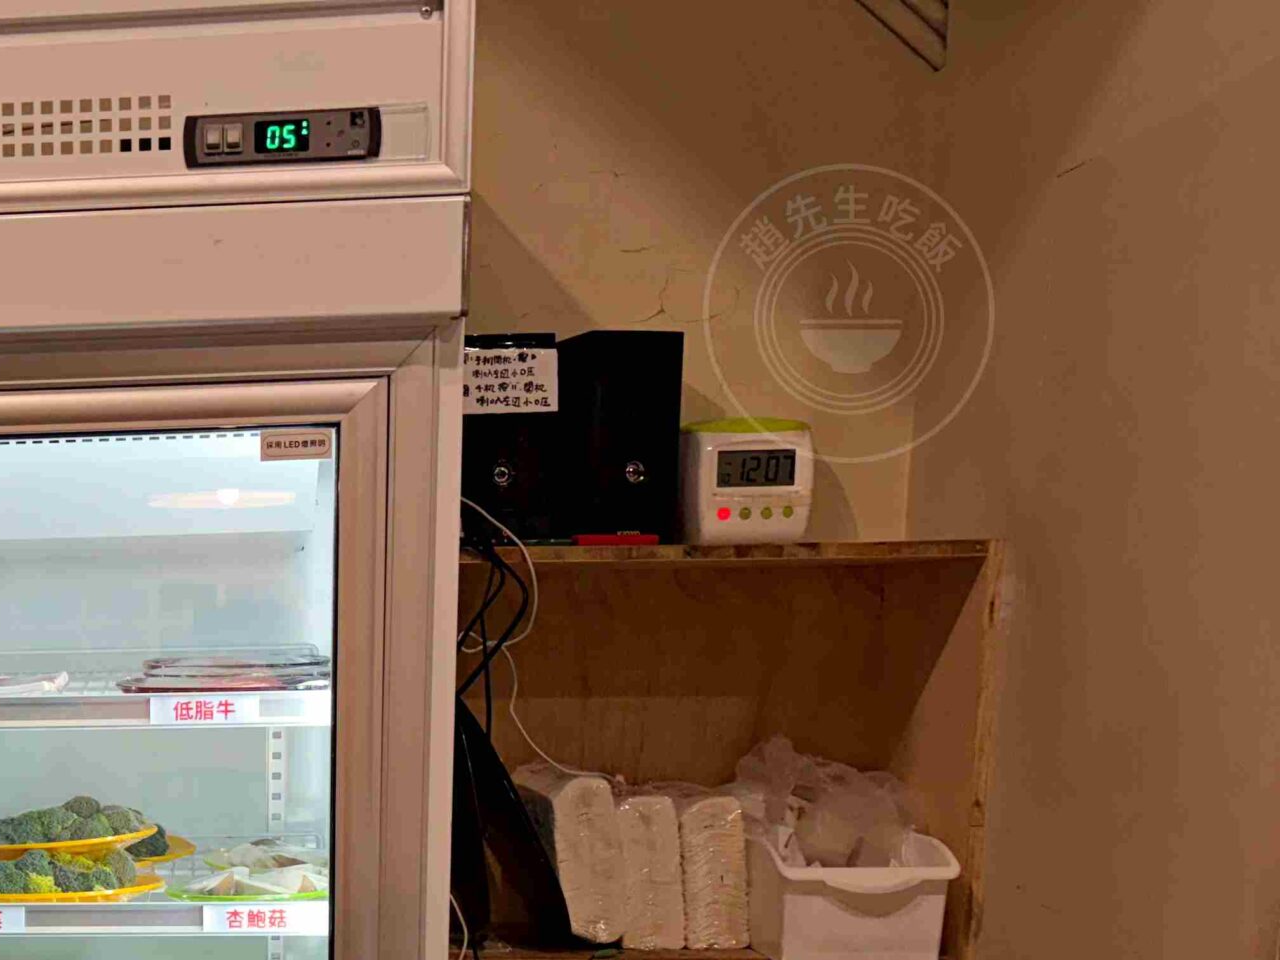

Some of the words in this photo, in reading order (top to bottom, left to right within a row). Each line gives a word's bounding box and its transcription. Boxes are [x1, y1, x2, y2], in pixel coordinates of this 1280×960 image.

[173, 699, 236, 721] 低脂牛
[226, 908, 287, 929] 杏鮑菇
